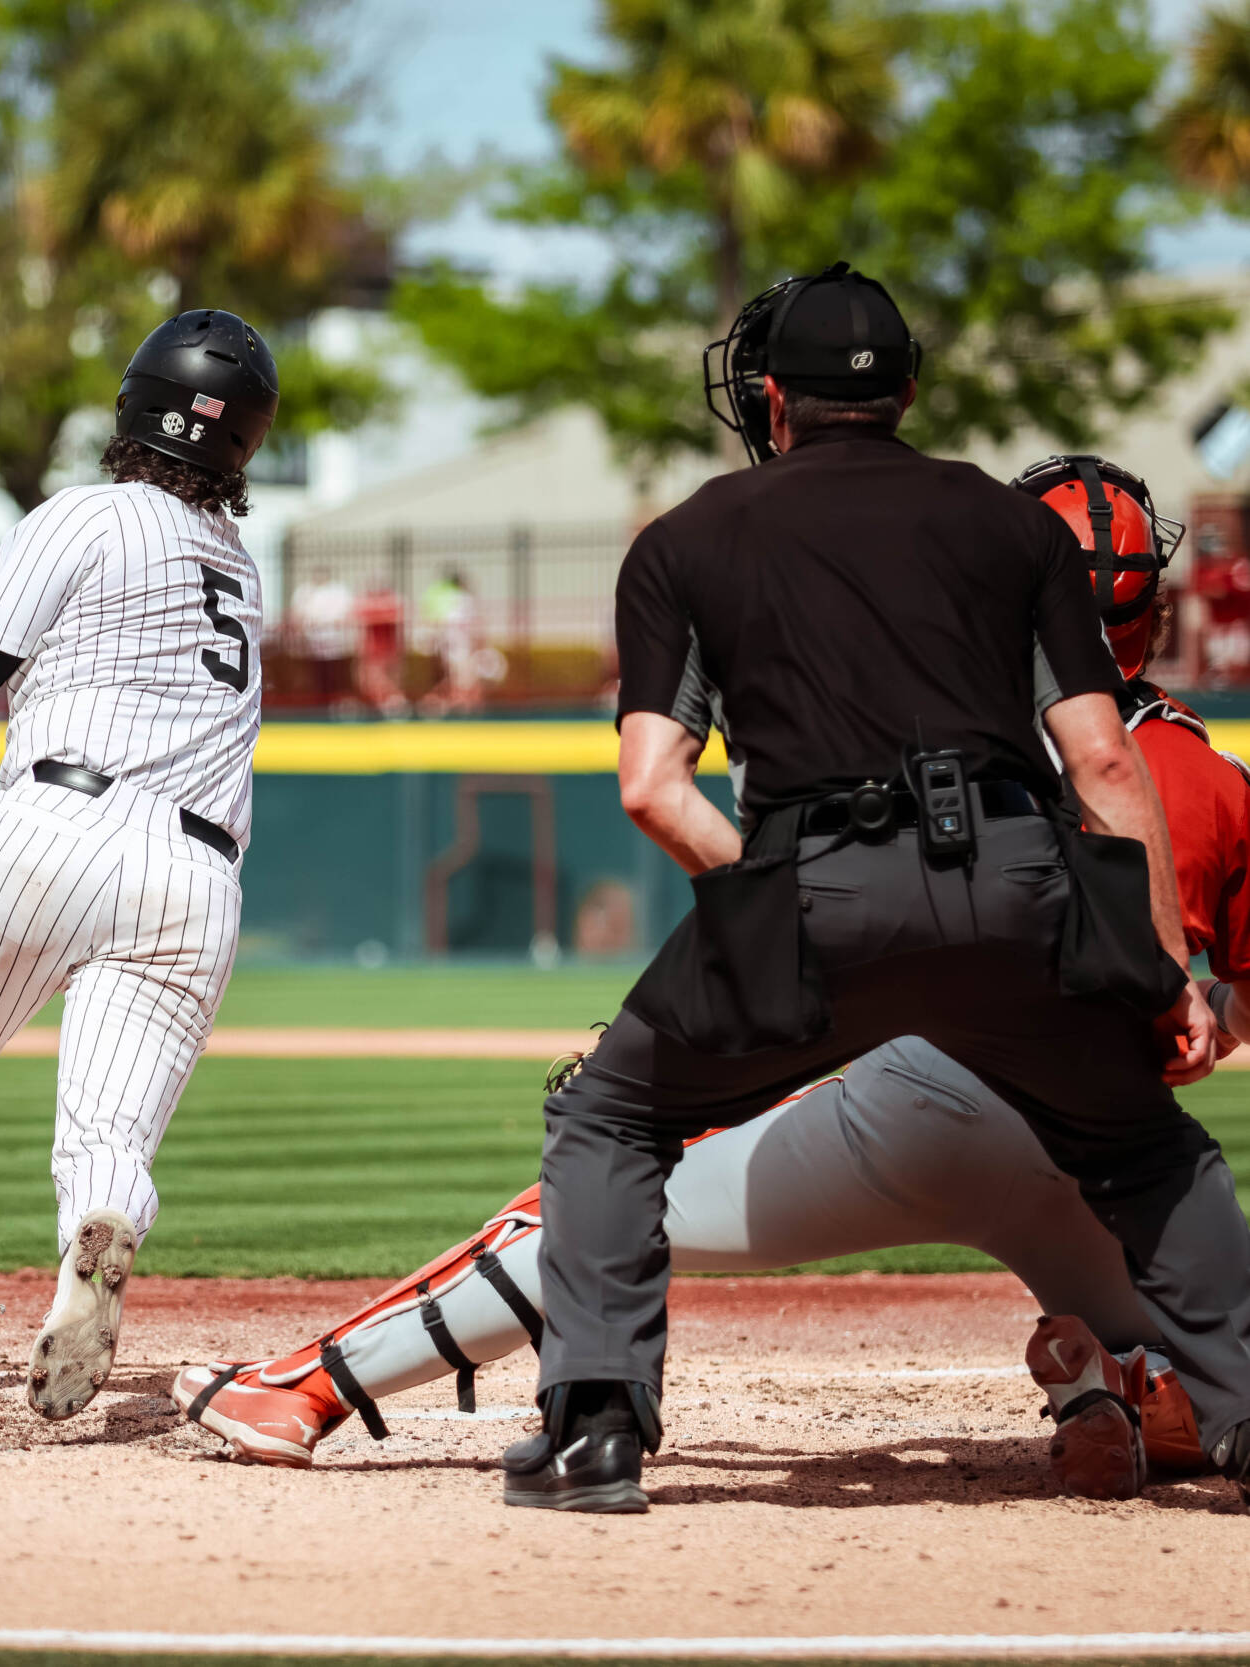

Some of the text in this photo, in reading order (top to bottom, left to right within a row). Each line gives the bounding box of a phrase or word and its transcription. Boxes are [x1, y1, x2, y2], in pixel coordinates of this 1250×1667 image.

[163, 413, 184, 435] SEC
[190, 423, 204, 442] 5
[200, 562, 249, 694] 5
